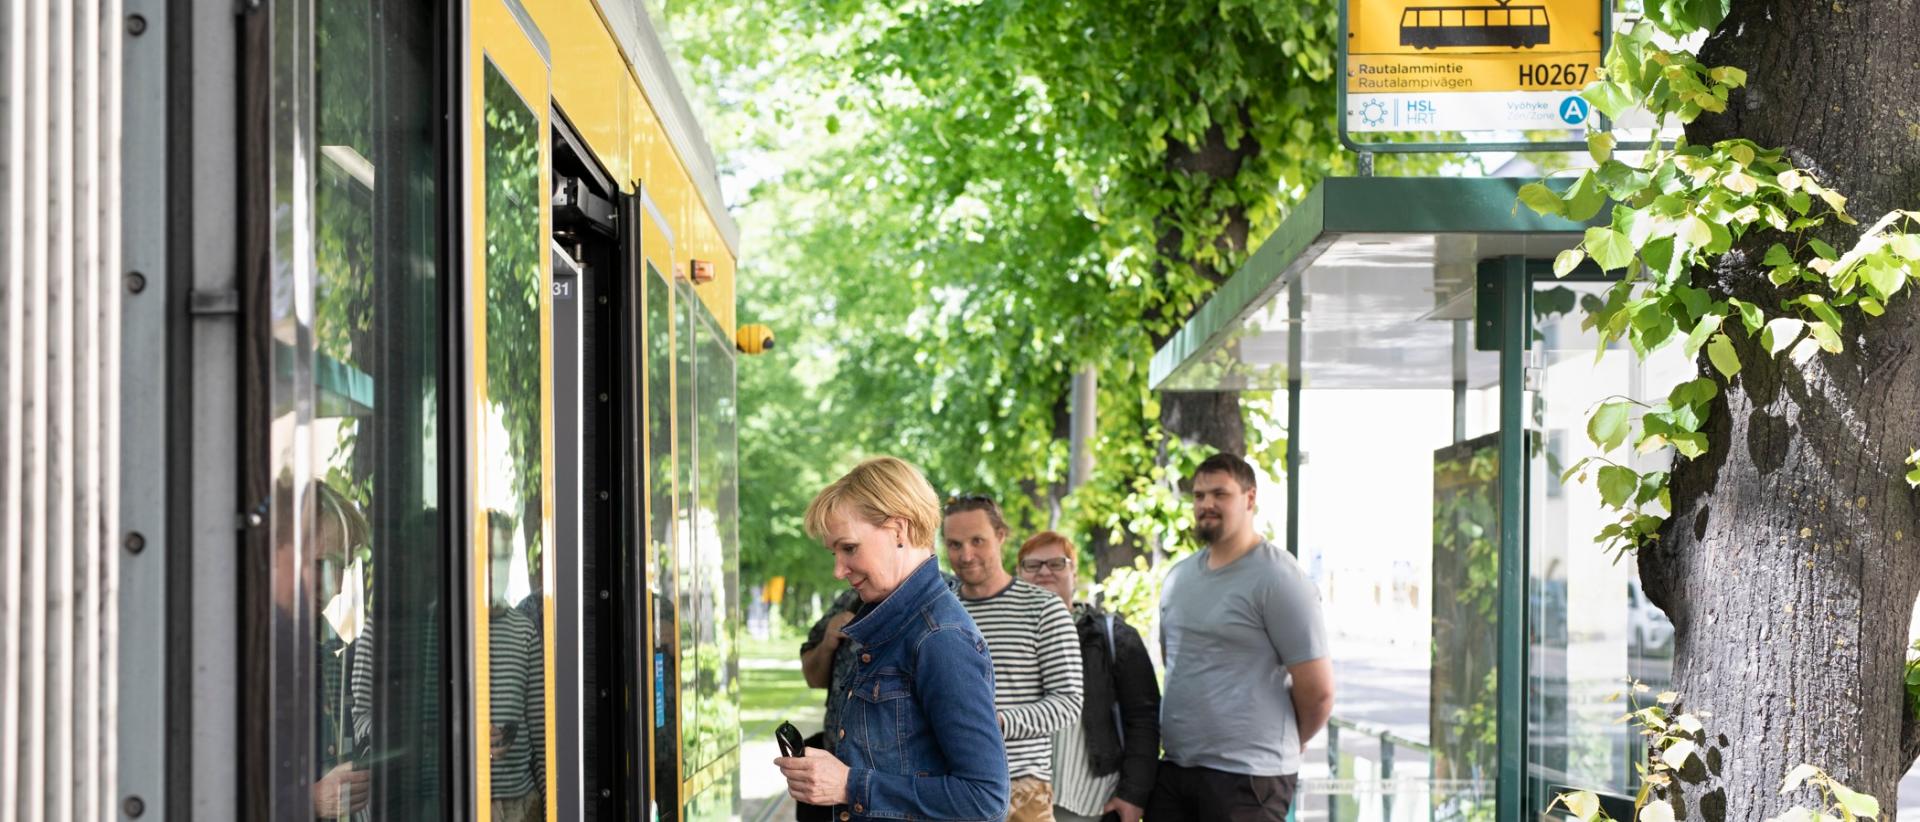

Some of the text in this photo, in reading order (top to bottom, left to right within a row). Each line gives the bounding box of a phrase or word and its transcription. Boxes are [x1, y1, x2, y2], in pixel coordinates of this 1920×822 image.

[1359, 63, 1463, 75] Rautalammintie
[1519, 63, 1589, 86] H0267
[1359, 77, 1473, 89] Rautalampivägen
[1407, 100, 1436, 112] HSL
[1563, 100, 1584, 119] A
[1407, 113, 1436, 124] HRT
